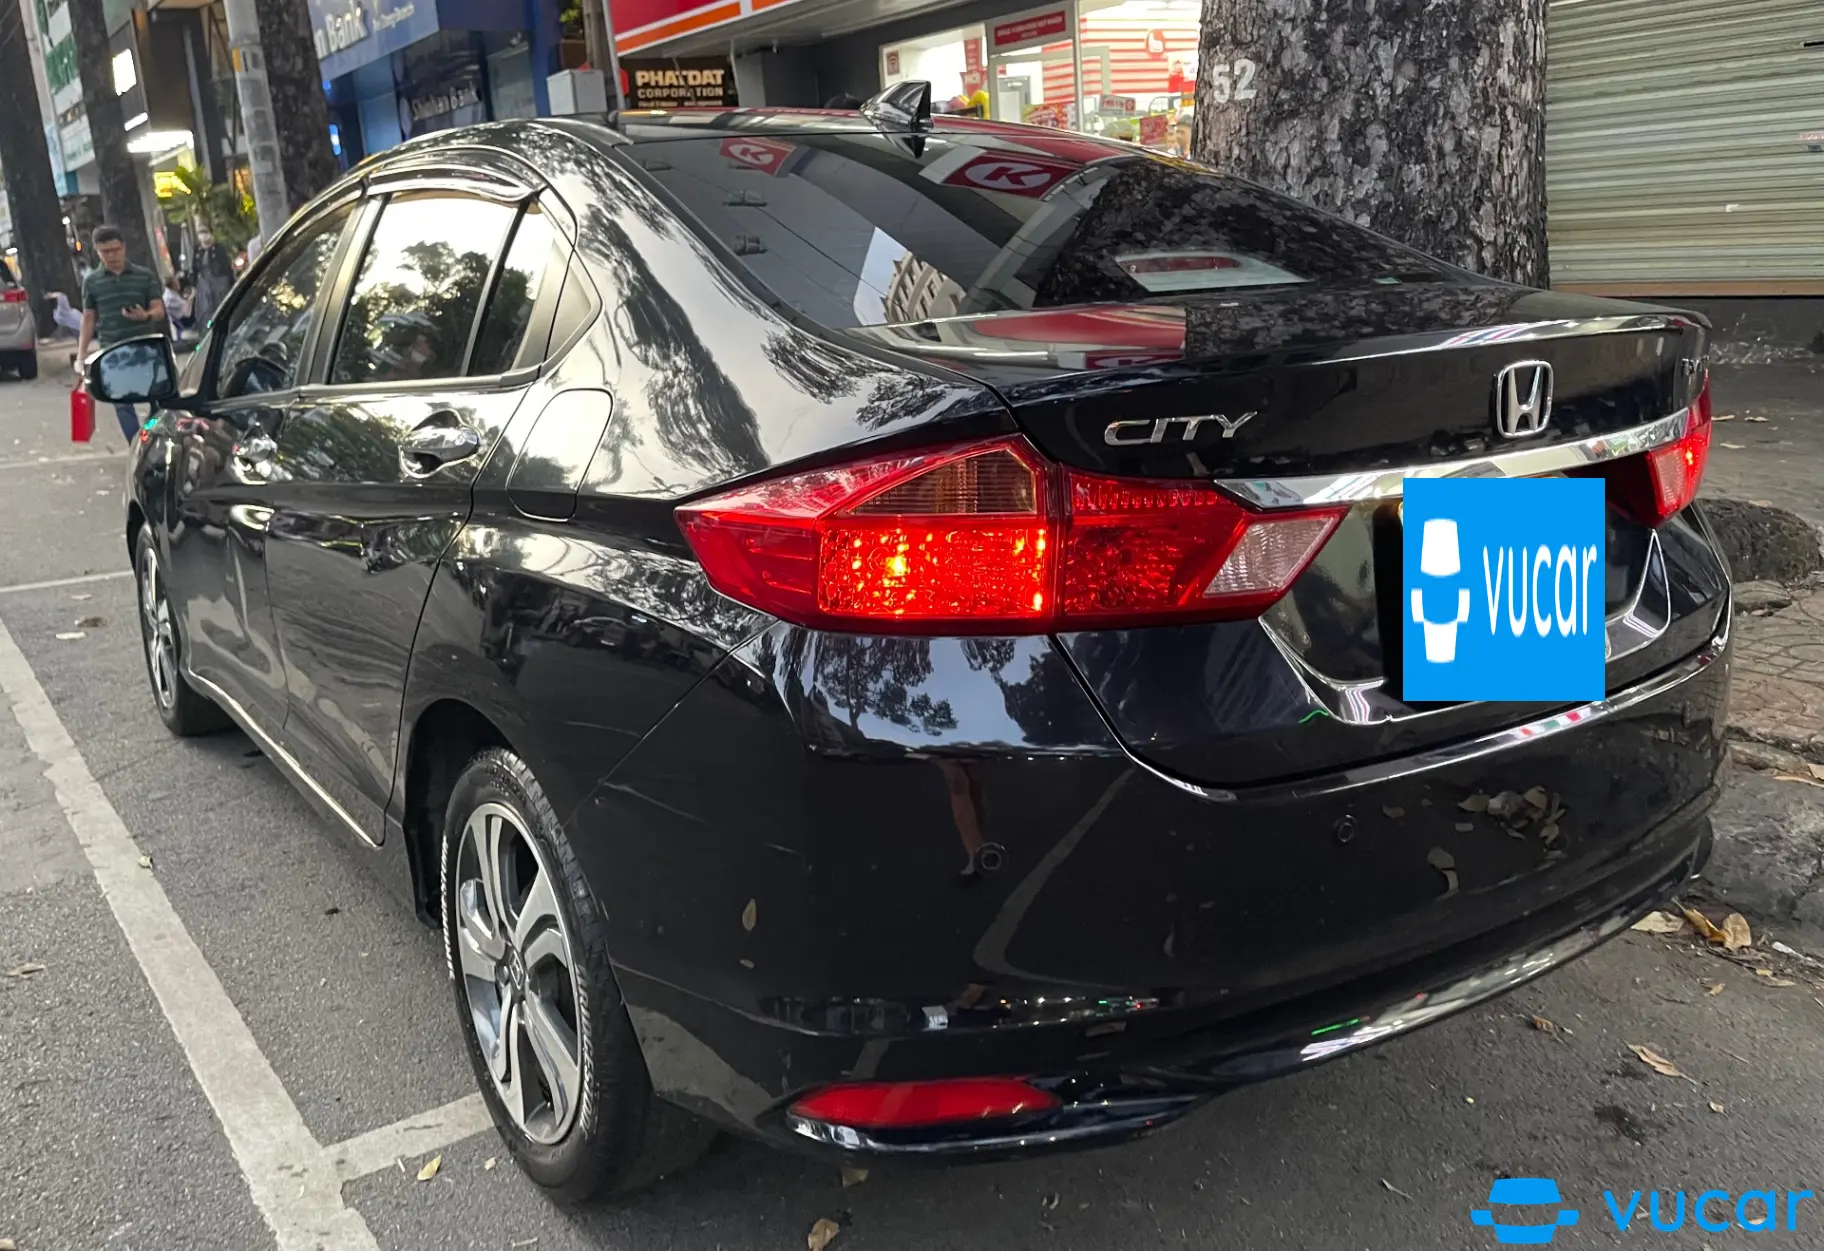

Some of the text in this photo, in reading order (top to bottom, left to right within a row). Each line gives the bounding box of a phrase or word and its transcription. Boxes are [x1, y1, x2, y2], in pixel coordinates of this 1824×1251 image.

[324, 0, 369, 54] Bank
[637, 87, 724, 99] CORPORATION
[1213, 58, 1257, 104] 52
[1104, 411, 1257, 446] CITY
